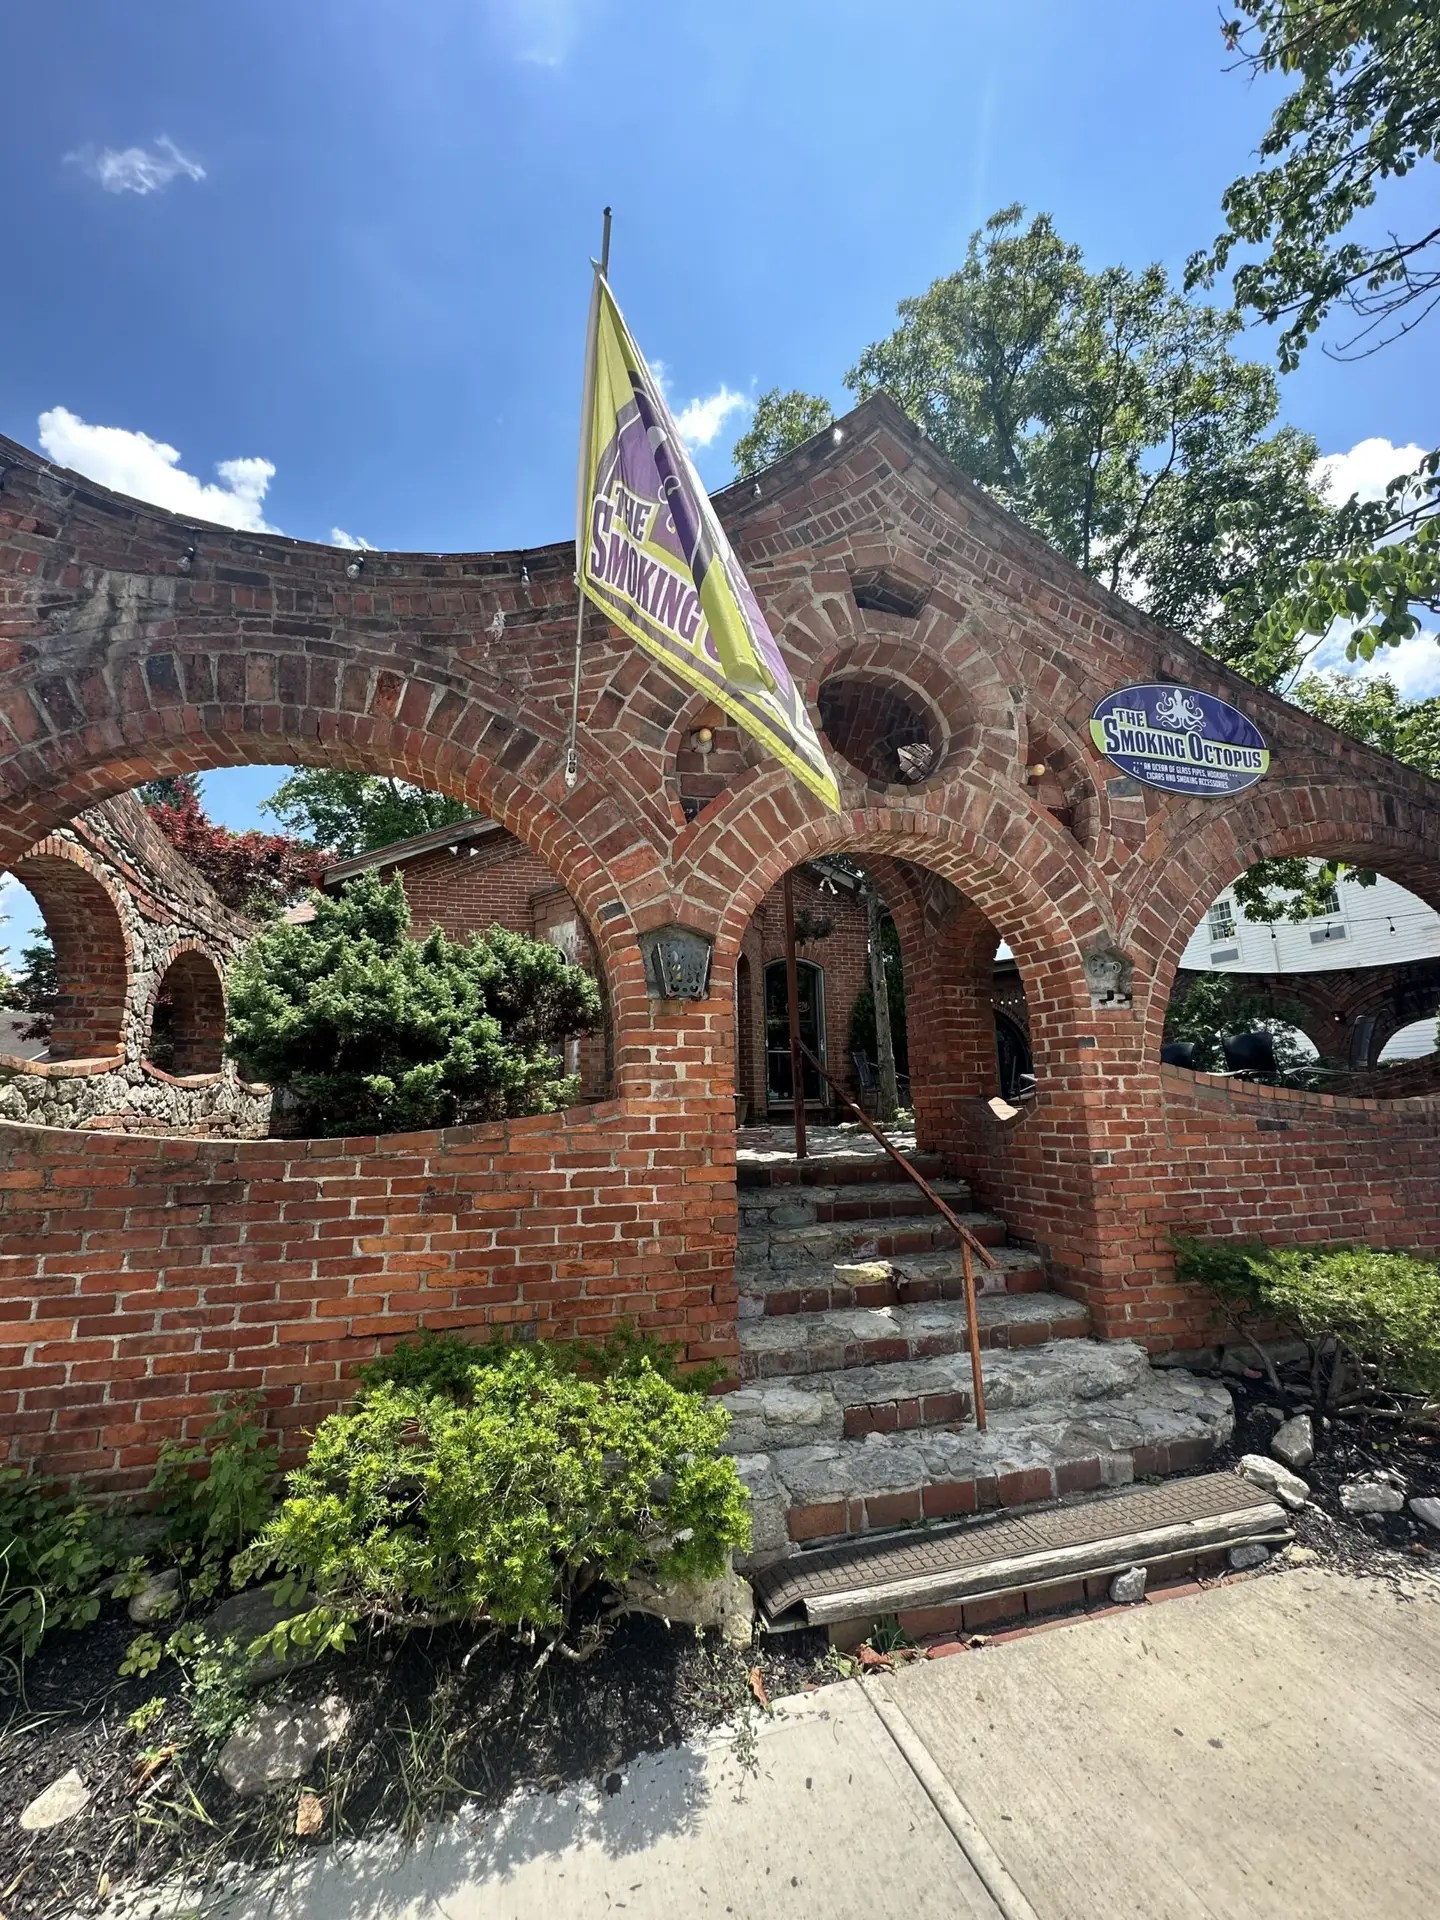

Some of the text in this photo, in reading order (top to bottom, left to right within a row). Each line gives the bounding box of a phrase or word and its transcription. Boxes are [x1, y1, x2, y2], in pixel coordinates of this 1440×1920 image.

[614, 487, 651, 541] THE
[591, 500, 704, 645] SMOKING
[1115, 710, 1145, 727] THE
[1152, 763, 1168, 772] OCEAN
[1169, 765, 1176, 773] OF
[1176, 766, 1191, 775] GLASS
[1146, 772, 1164, 781] CIGARS
[1165, 774, 1176, 782] AND
[1176, 775, 1198, 785] SMOKING
